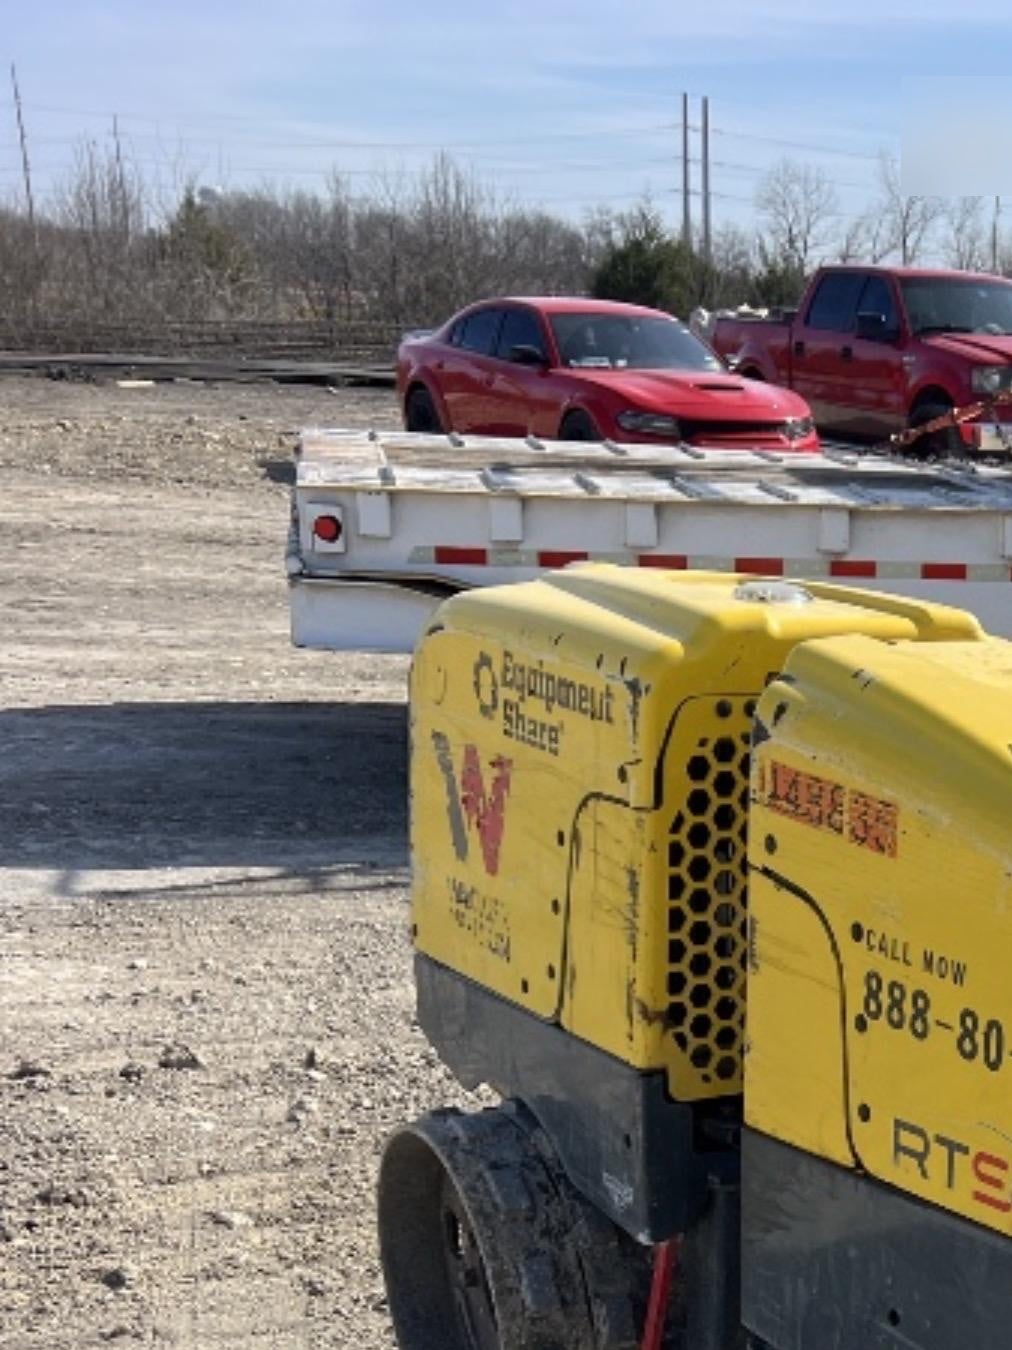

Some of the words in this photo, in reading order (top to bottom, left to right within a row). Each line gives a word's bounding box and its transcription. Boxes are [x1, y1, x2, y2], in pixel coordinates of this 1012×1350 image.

[502, 649, 614, 724] Equipment
[503, 698, 559, 757] Share
[866, 929, 912, 966] CALL
[922, 950, 967, 986] NOW
